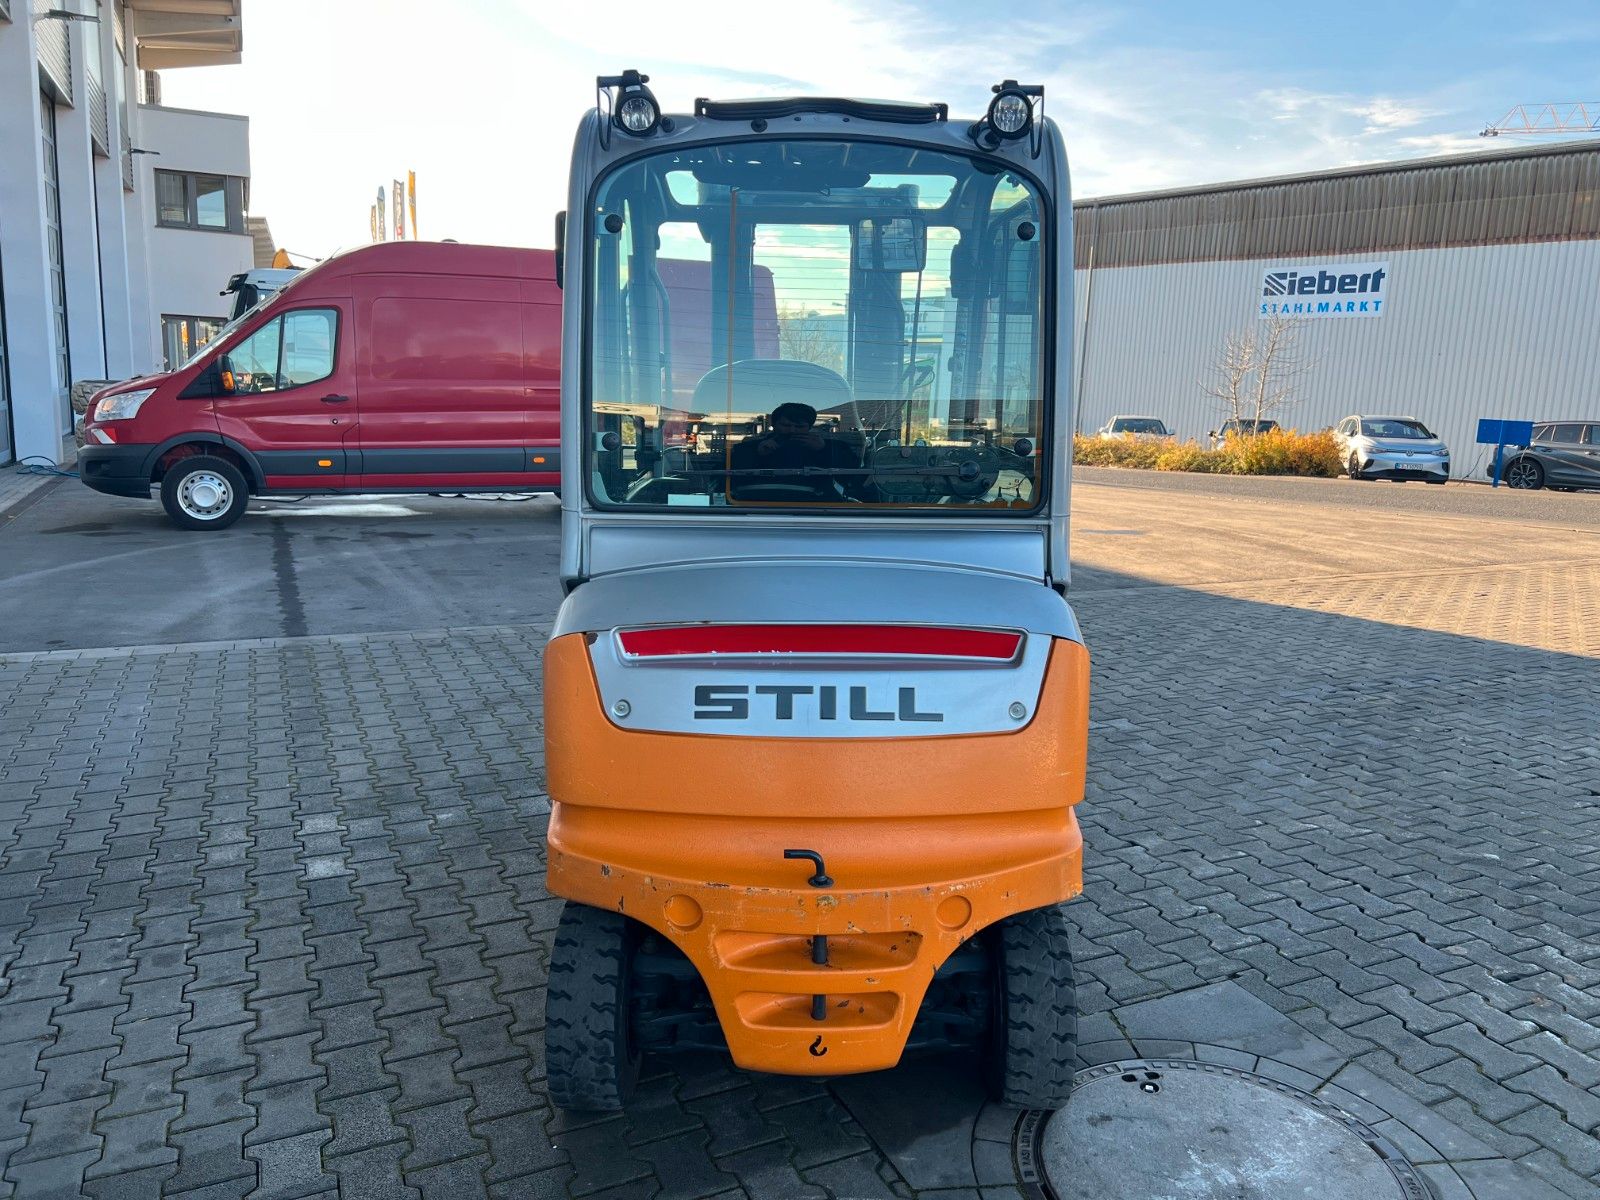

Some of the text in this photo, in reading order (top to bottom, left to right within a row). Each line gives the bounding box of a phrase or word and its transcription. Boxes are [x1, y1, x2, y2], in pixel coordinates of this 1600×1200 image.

[1263, 268, 1386, 296] Siebert
[1260, 300, 1382, 314] STAHLMARKT
[694, 685, 944, 722] STILL
